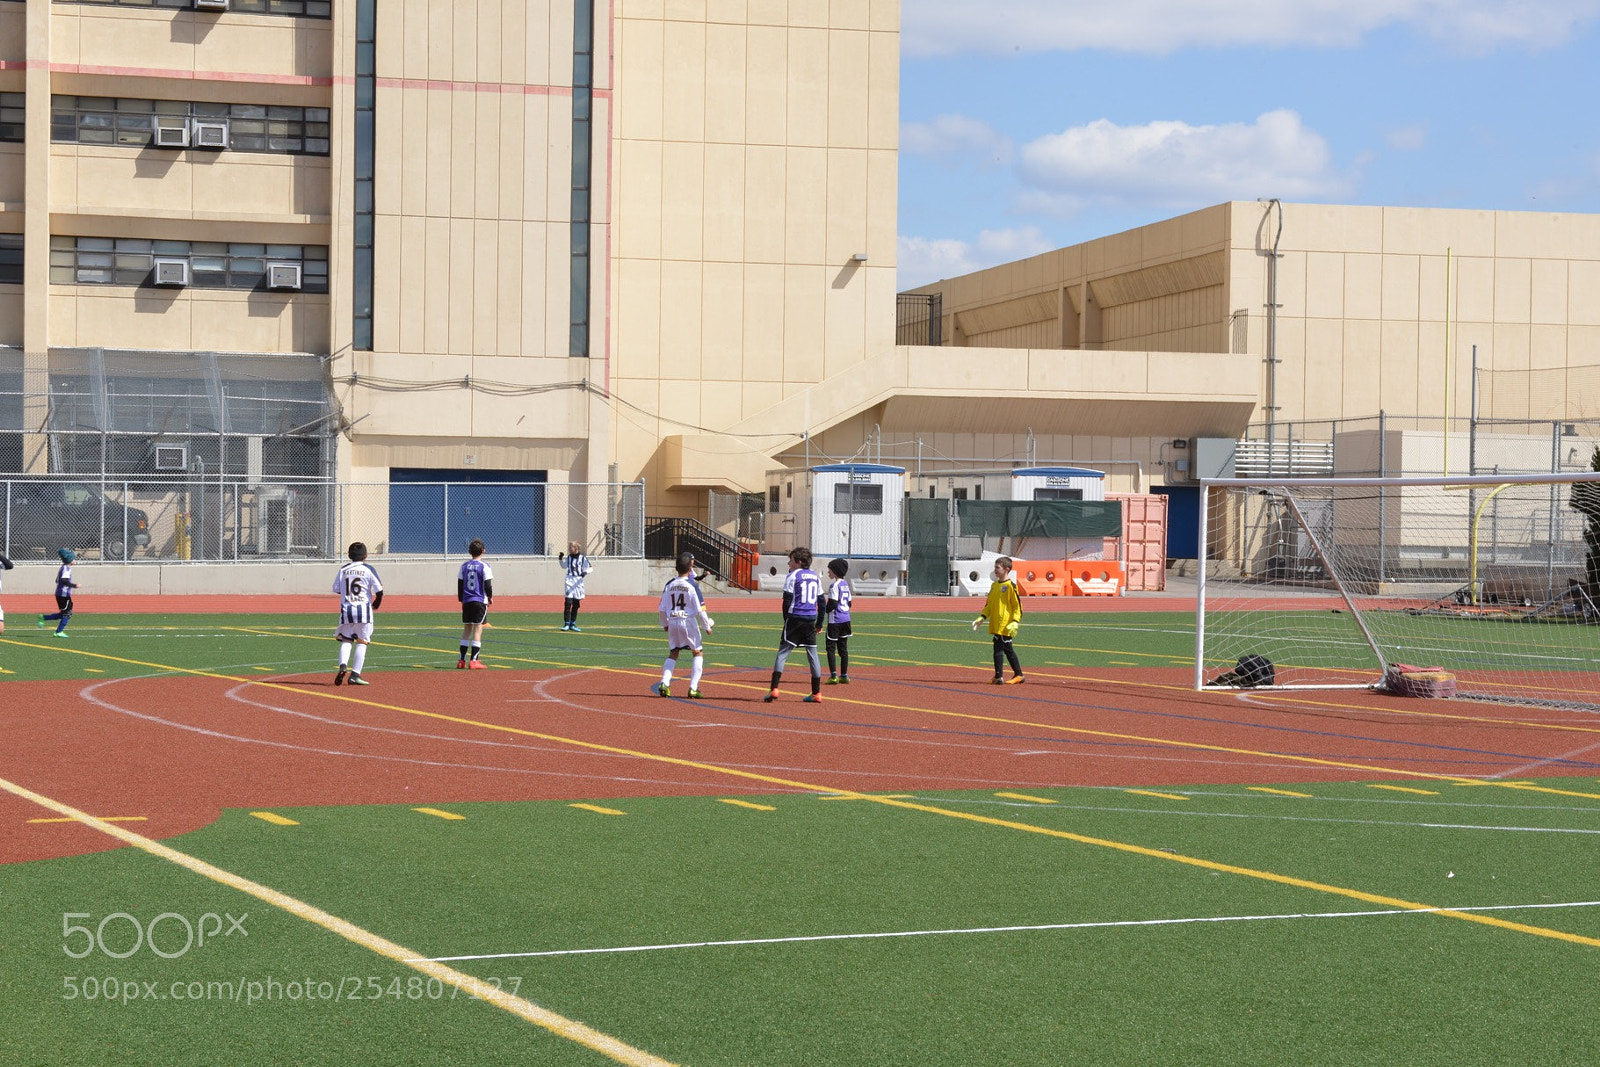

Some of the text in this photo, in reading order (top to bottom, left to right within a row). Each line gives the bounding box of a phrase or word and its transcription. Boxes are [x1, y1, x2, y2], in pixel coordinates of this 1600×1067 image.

[345, 577, 361, 596] 16
[467, 571, 476, 591] 8
[670, 593, 687, 611] 14
[800, 581, 818, 604] 10
[840, 592, 850, 612] 5
